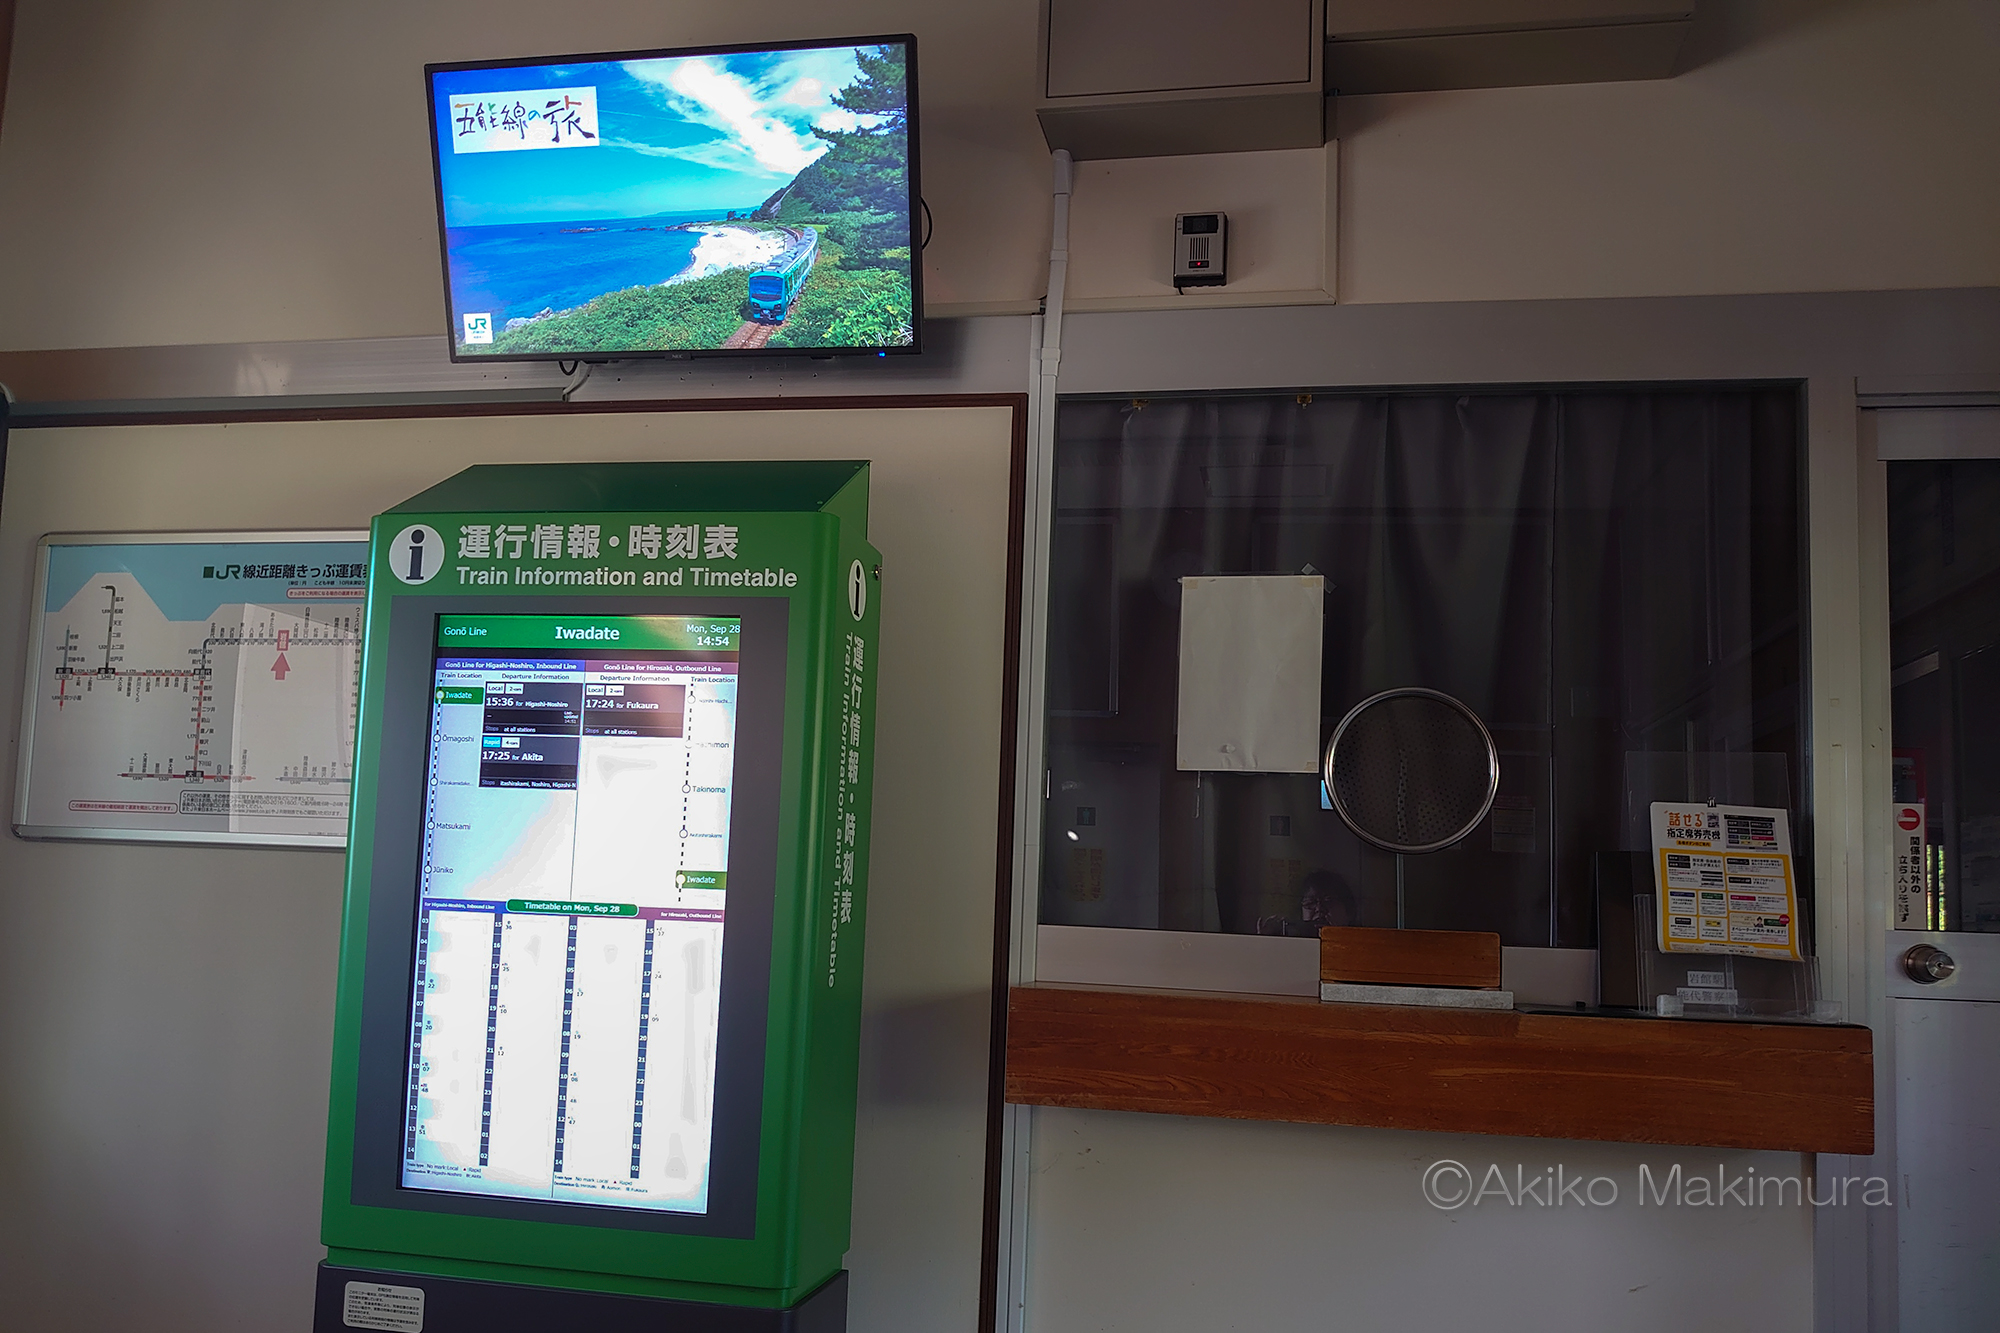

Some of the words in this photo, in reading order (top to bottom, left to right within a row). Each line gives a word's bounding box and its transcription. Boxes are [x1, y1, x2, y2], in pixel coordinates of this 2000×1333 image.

[468, 318, 486, 330] JR
[457, 524, 739, 560] 運行情報・時刻表
[456, 566, 512, 586] Train
[515, 566, 637, 586] Information
[642, 567, 684, 586] and
[689, 568, 798, 588] Timetable
[469, 627, 487, 636] Line
[555, 626, 620, 641] Iwadate
[686, 625, 707, 634] Mon,
[710, 625, 726, 634] Sep
[697, 637, 729, 646] 14:54
[486, 698, 514, 707] 15:36
[586, 699, 614, 708] 17:24
[482, 751, 510, 760] 17:25
[522, 753, 543, 761] Akita
[1668, 812, 1702, 827] 話せる
[1910, 836, 1921, 894] 関係者以外の
[524, 902, 561, 910] Timetable
